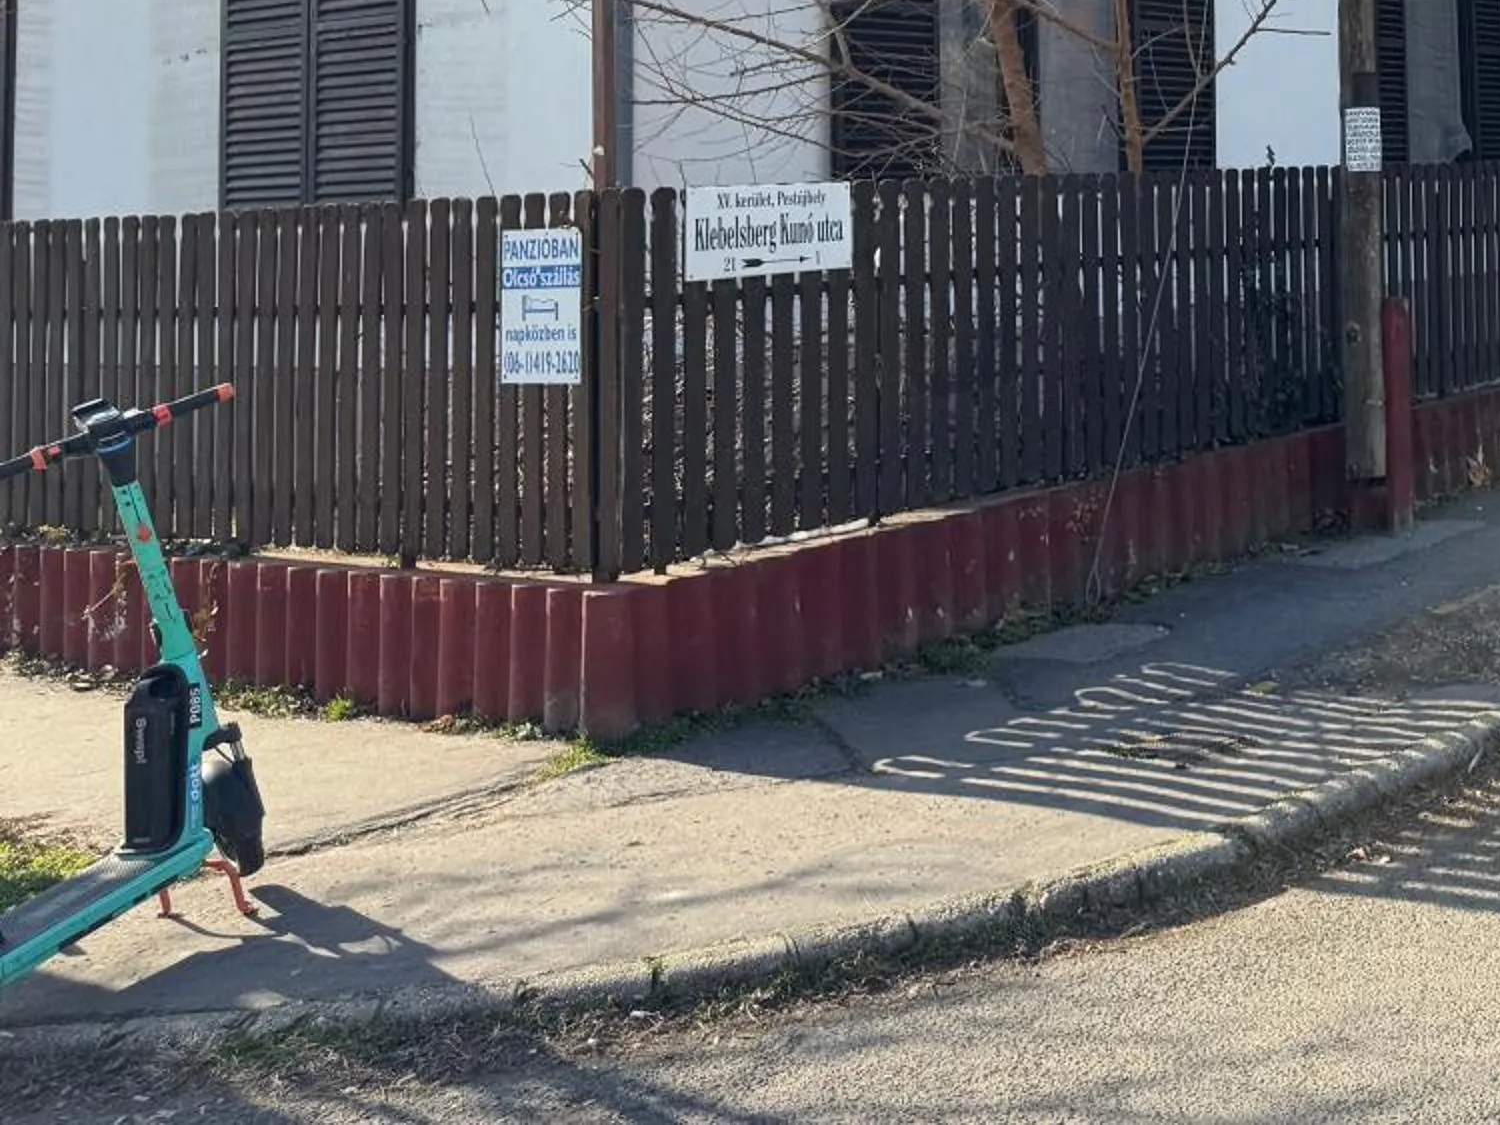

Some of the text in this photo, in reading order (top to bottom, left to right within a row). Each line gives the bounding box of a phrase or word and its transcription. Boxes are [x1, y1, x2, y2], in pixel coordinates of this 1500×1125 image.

[717, 192, 733, 210] XV.
[694, 212, 844, 254] Klebelsberg Kunó utca
[723, 256, 737, 273] 21
[505, 323, 577, 346] napközben is
